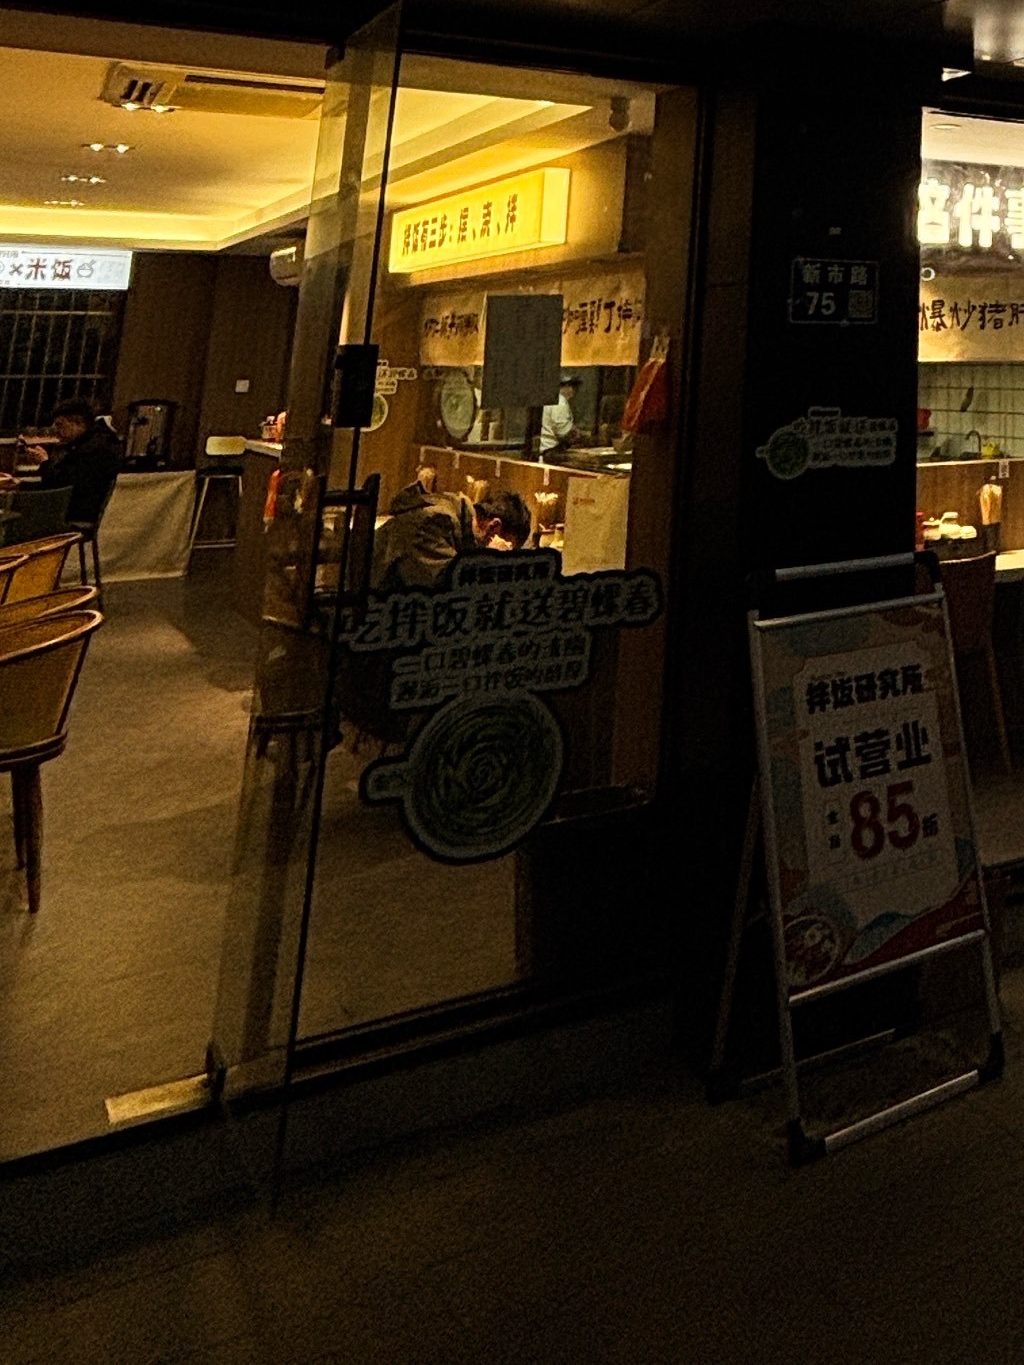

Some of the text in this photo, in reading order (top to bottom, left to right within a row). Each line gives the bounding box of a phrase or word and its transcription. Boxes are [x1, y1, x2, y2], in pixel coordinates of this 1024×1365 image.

[801, 263, 869, 285] 新市路
[804, 291, 837, 316] 75
[814, 720, 931, 787] 试营业
